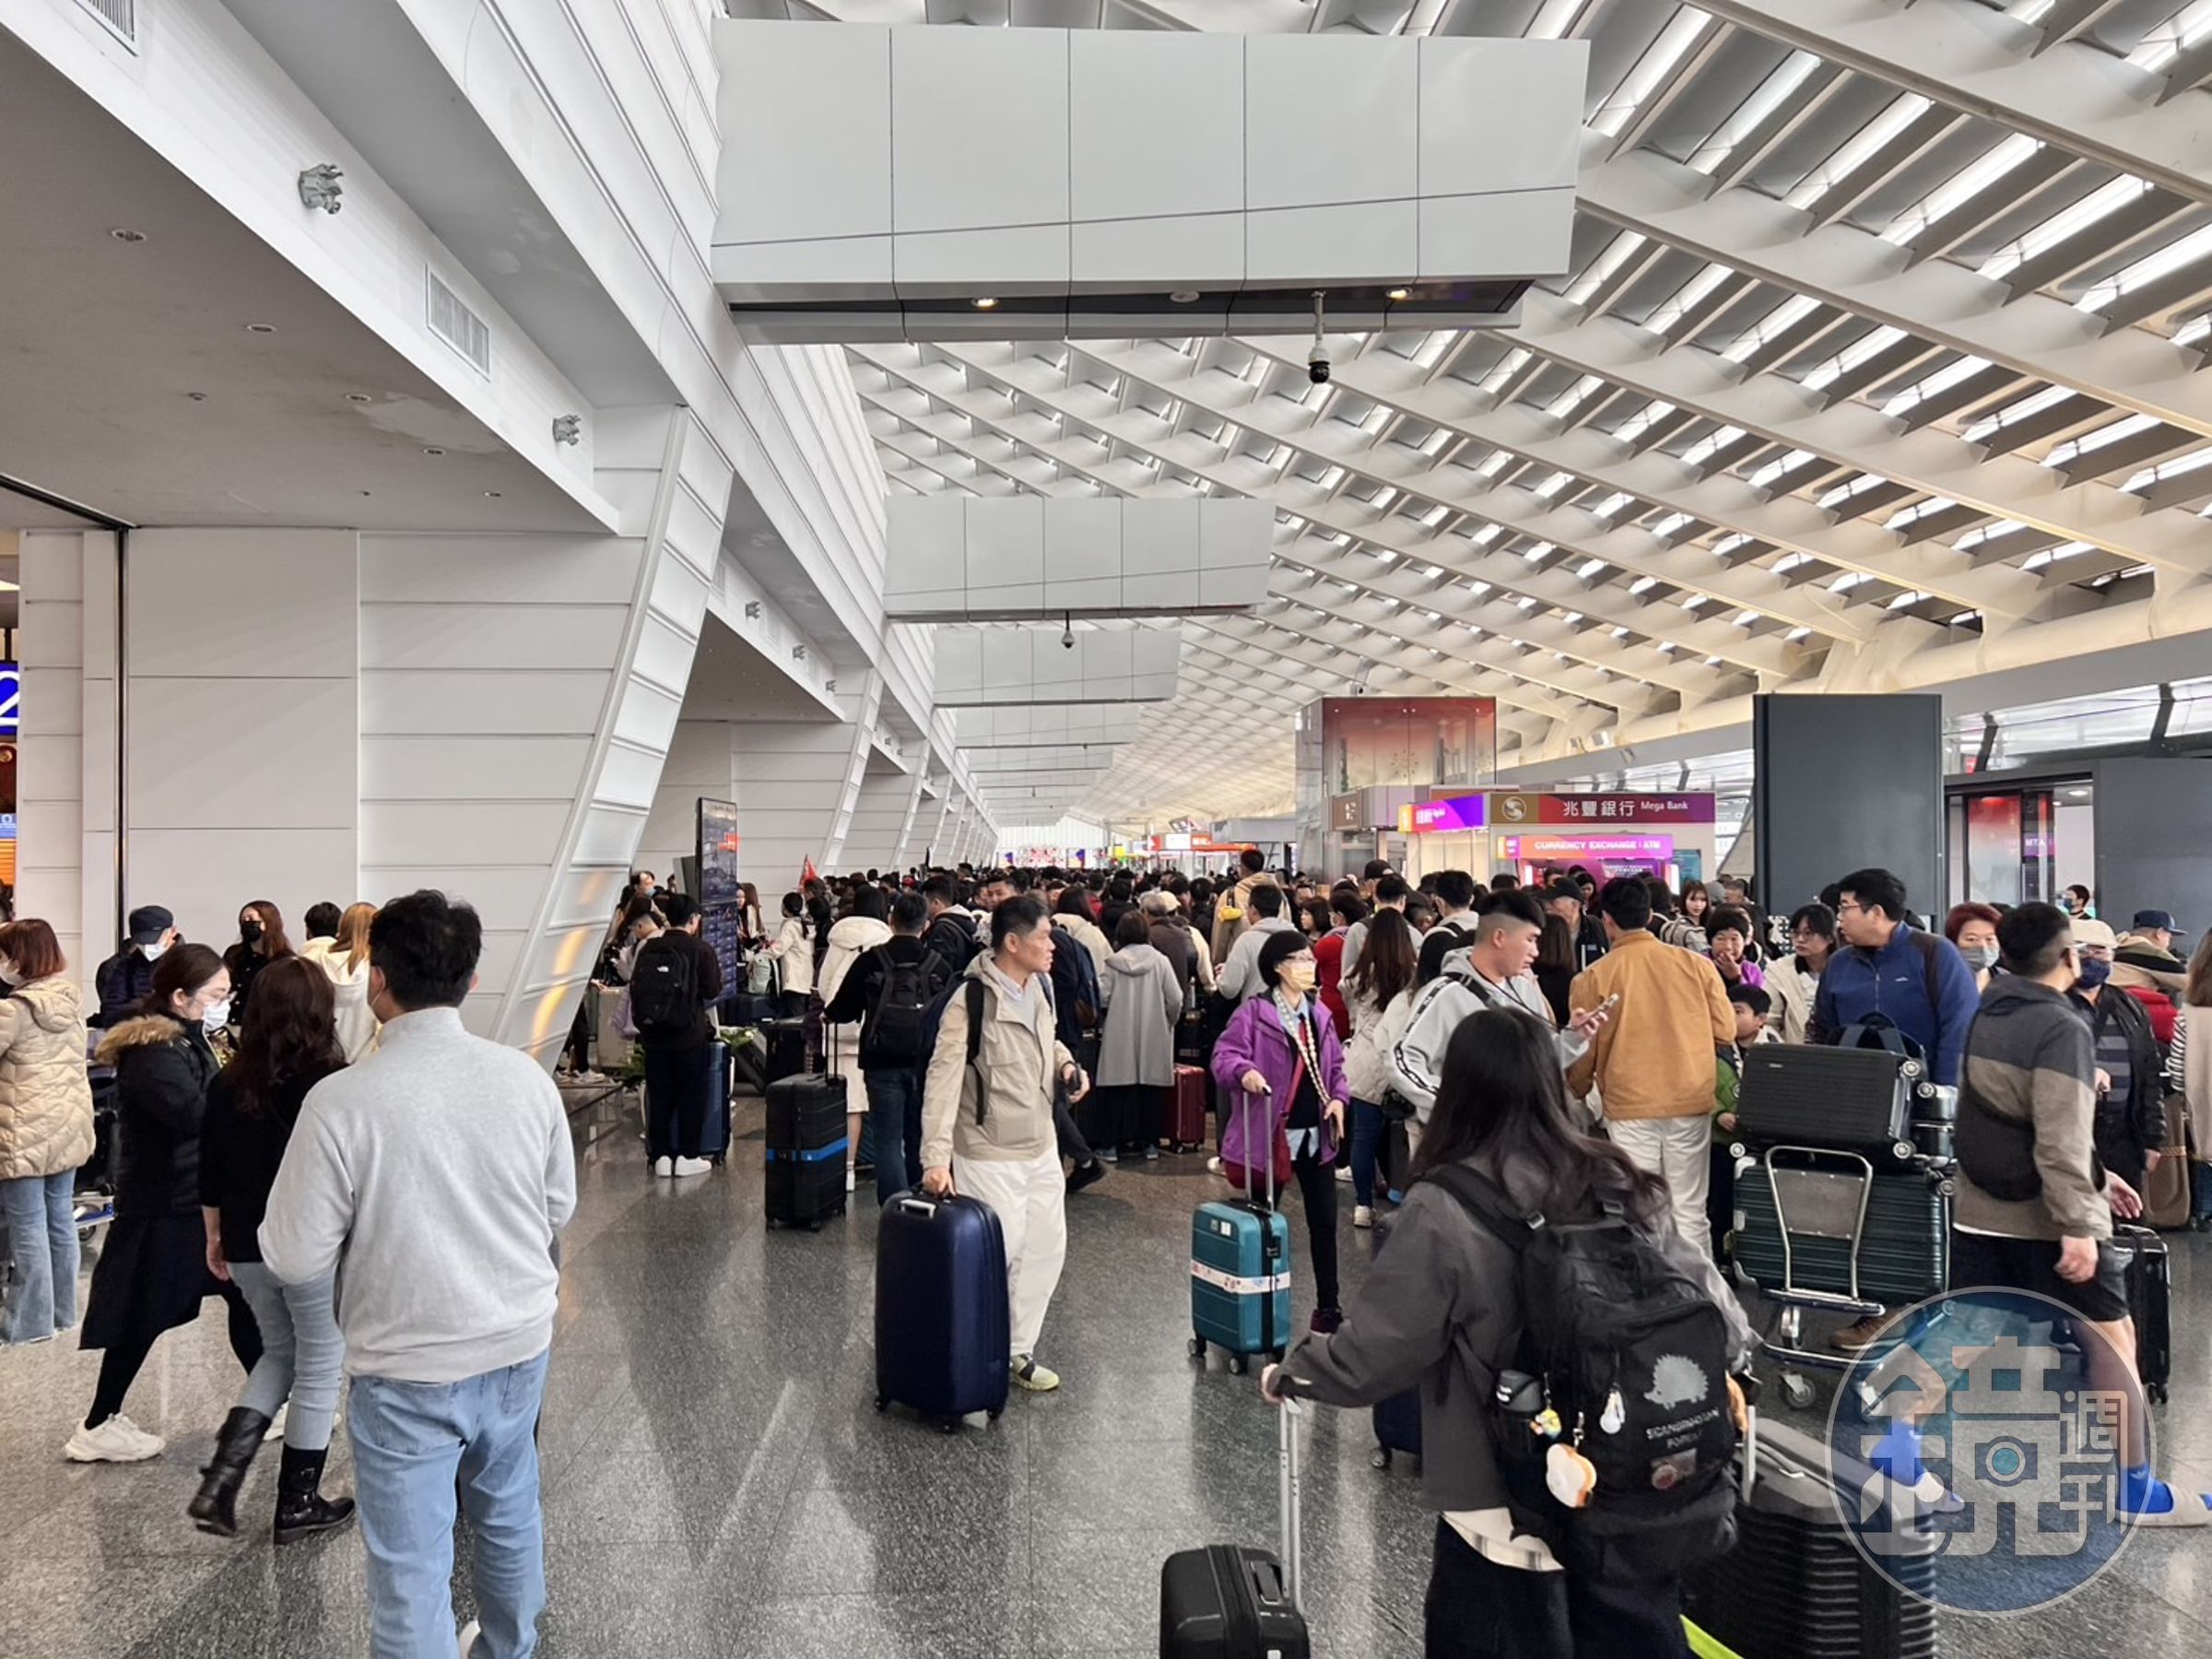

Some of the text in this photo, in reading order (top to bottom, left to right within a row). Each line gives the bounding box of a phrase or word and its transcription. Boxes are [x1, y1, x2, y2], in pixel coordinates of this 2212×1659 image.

[1563, 800, 1636, 818] 兆豐銀行
[1641, 800, 1689, 812] Mega Bank
[1535, 841, 1662, 850] CURRENCY EXCHANGE ATM
